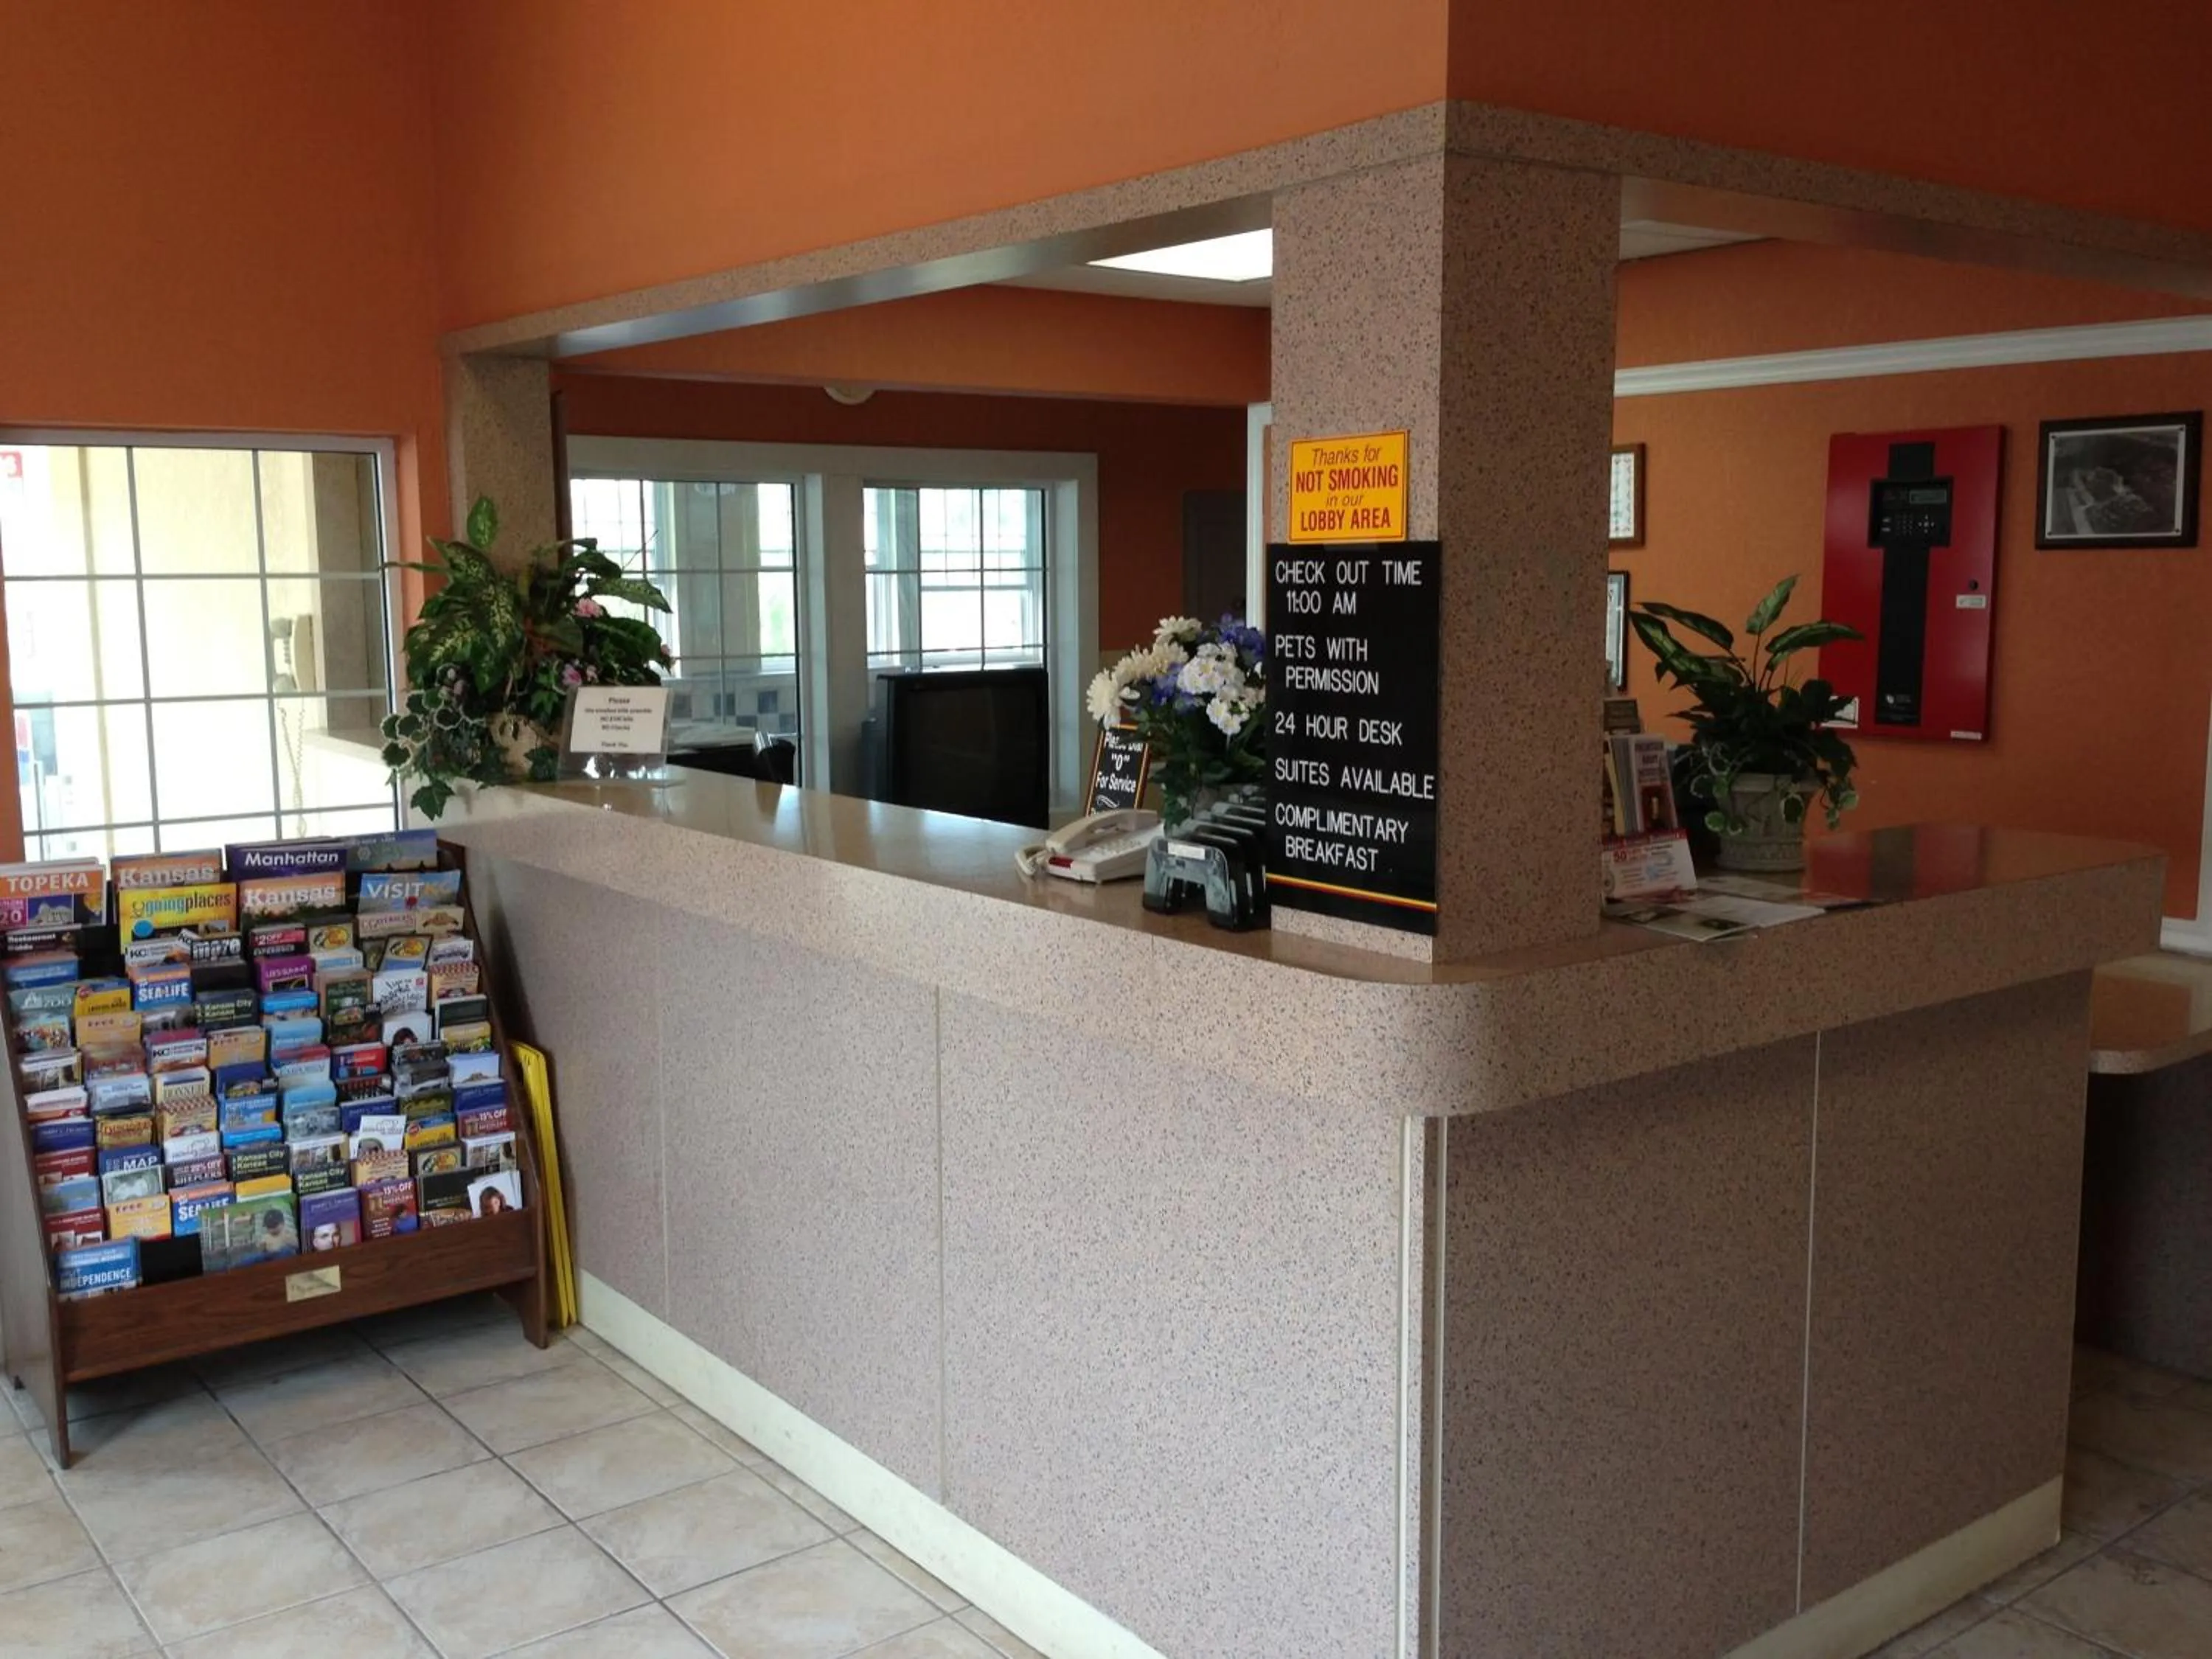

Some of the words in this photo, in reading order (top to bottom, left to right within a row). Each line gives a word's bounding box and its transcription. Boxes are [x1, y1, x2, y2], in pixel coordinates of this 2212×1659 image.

[1312, 448, 1358, 466] Thanks
[1364, 444, 1381, 462] for
[1295, 470, 1324, 493] NOT
[1328, 464, 1398, 491] SMOKING
[1326, 495, 1338, 507] in
[1342, 494, 1363, 507] our
[1301, 509, 1345, 532] LOBBY
[1351, 507, 1391, 529] AREA
[1275, 560, 1325, 584] CHECK
[1336, 560, 1369, 585] OUT
[1382, 560, 1422, 585] TIME
[1287, 590, 1321, 613] 11:00
[1332, 591, 1356, 614] AM
[1275, 634, 1315, 658] PETS
[1326, 636, 1368, 661] WITH
[1286, 666, 1379, 695] PERMISSION
[1275, 711, 1295, 735] 24
[1306, 714, 1348, 740] HOUR
[1359, 719, 1402, 746] DESK
[1096, 771, 1109, 788] For
[1109, 773, 1136, 793] Service
[1275, 757, 1329, 786] SUITES
[1340, 766, 1434, 800] AVAILABLE
[1275, 802, 1409, 844] COMPLIMENTARY
[245, 851, 338, 866] Manhattan
[1285, 835, 1379, 872] BREAKFAST
[7, 872, 88, 893] TOPEKA
[120, 866, 214, 887] Kansas
[244, 886, 335, 908] Kansas
[366, 882, 425, 899] VISIT
[138, 987, 163, 1003] SEA
[164, 982, 189, 998] LIFE
[123, 1155, 157, 1171] MAP
